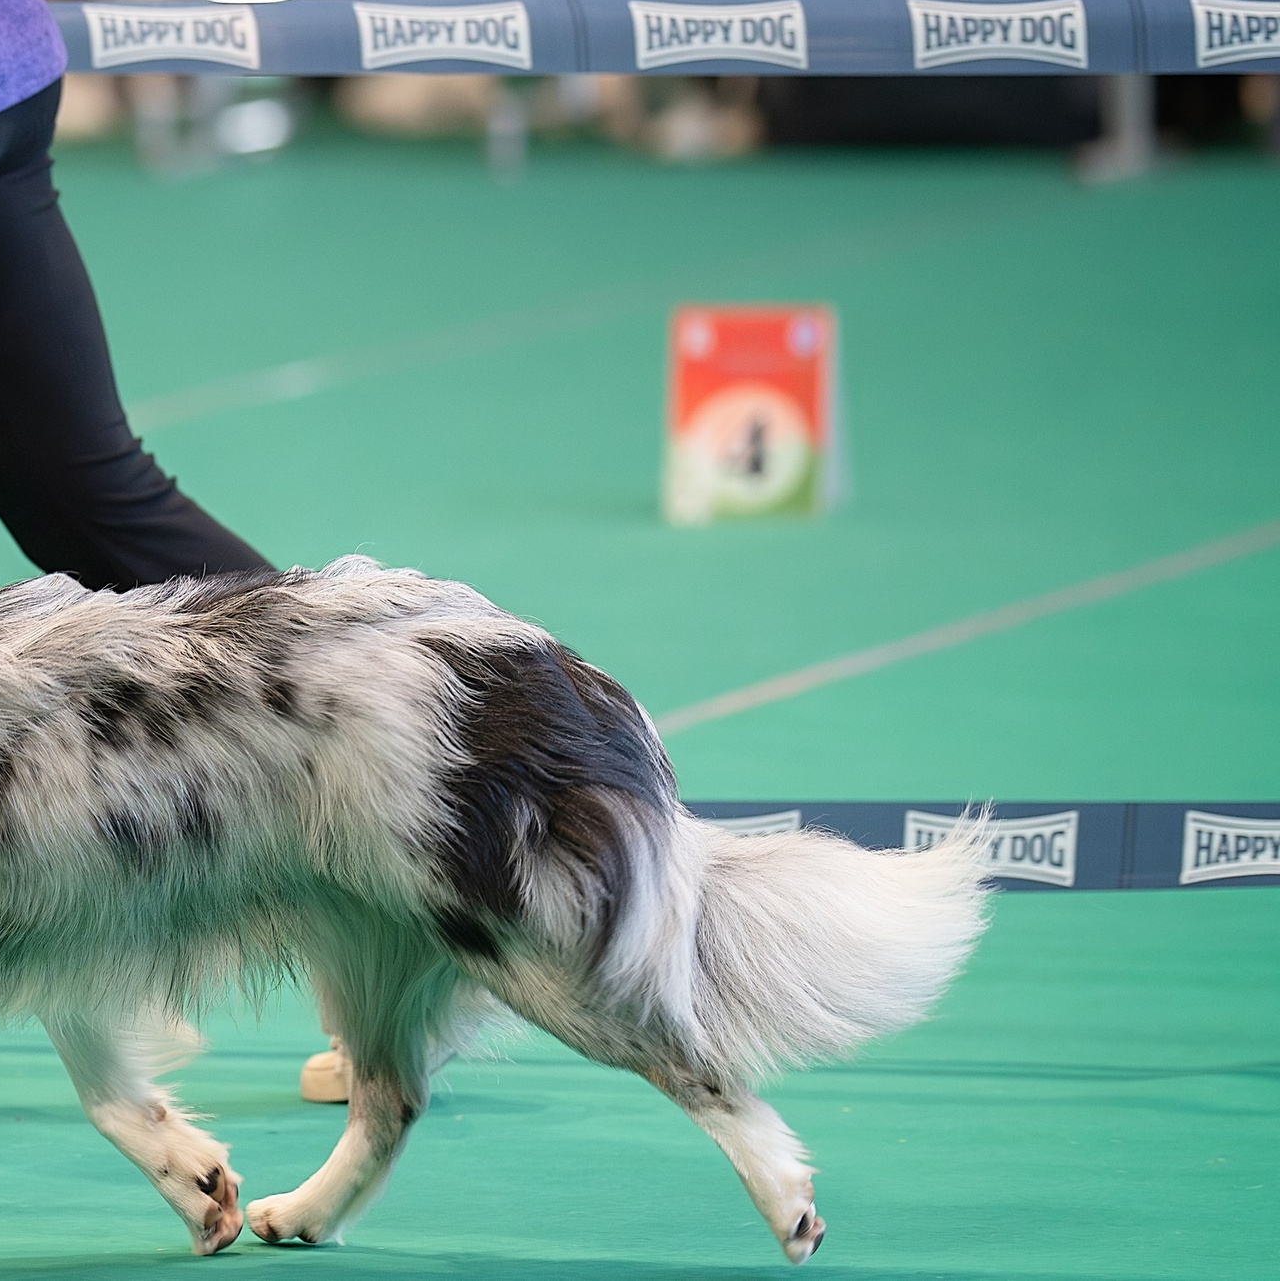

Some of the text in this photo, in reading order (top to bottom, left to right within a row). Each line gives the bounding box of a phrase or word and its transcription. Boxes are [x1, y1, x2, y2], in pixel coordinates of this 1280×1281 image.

[99, 15, 247, 51] HAPPY DOG
[369, 13, 520, 50] HAPPY DOG
[644, 13, 797, 51] HAPPY DOG
[923, 12, 1077, 50] HAPPY DOG
[1205, 10, 1280, 49] HAPP
[1011, 830, 1065, 867] DOG
